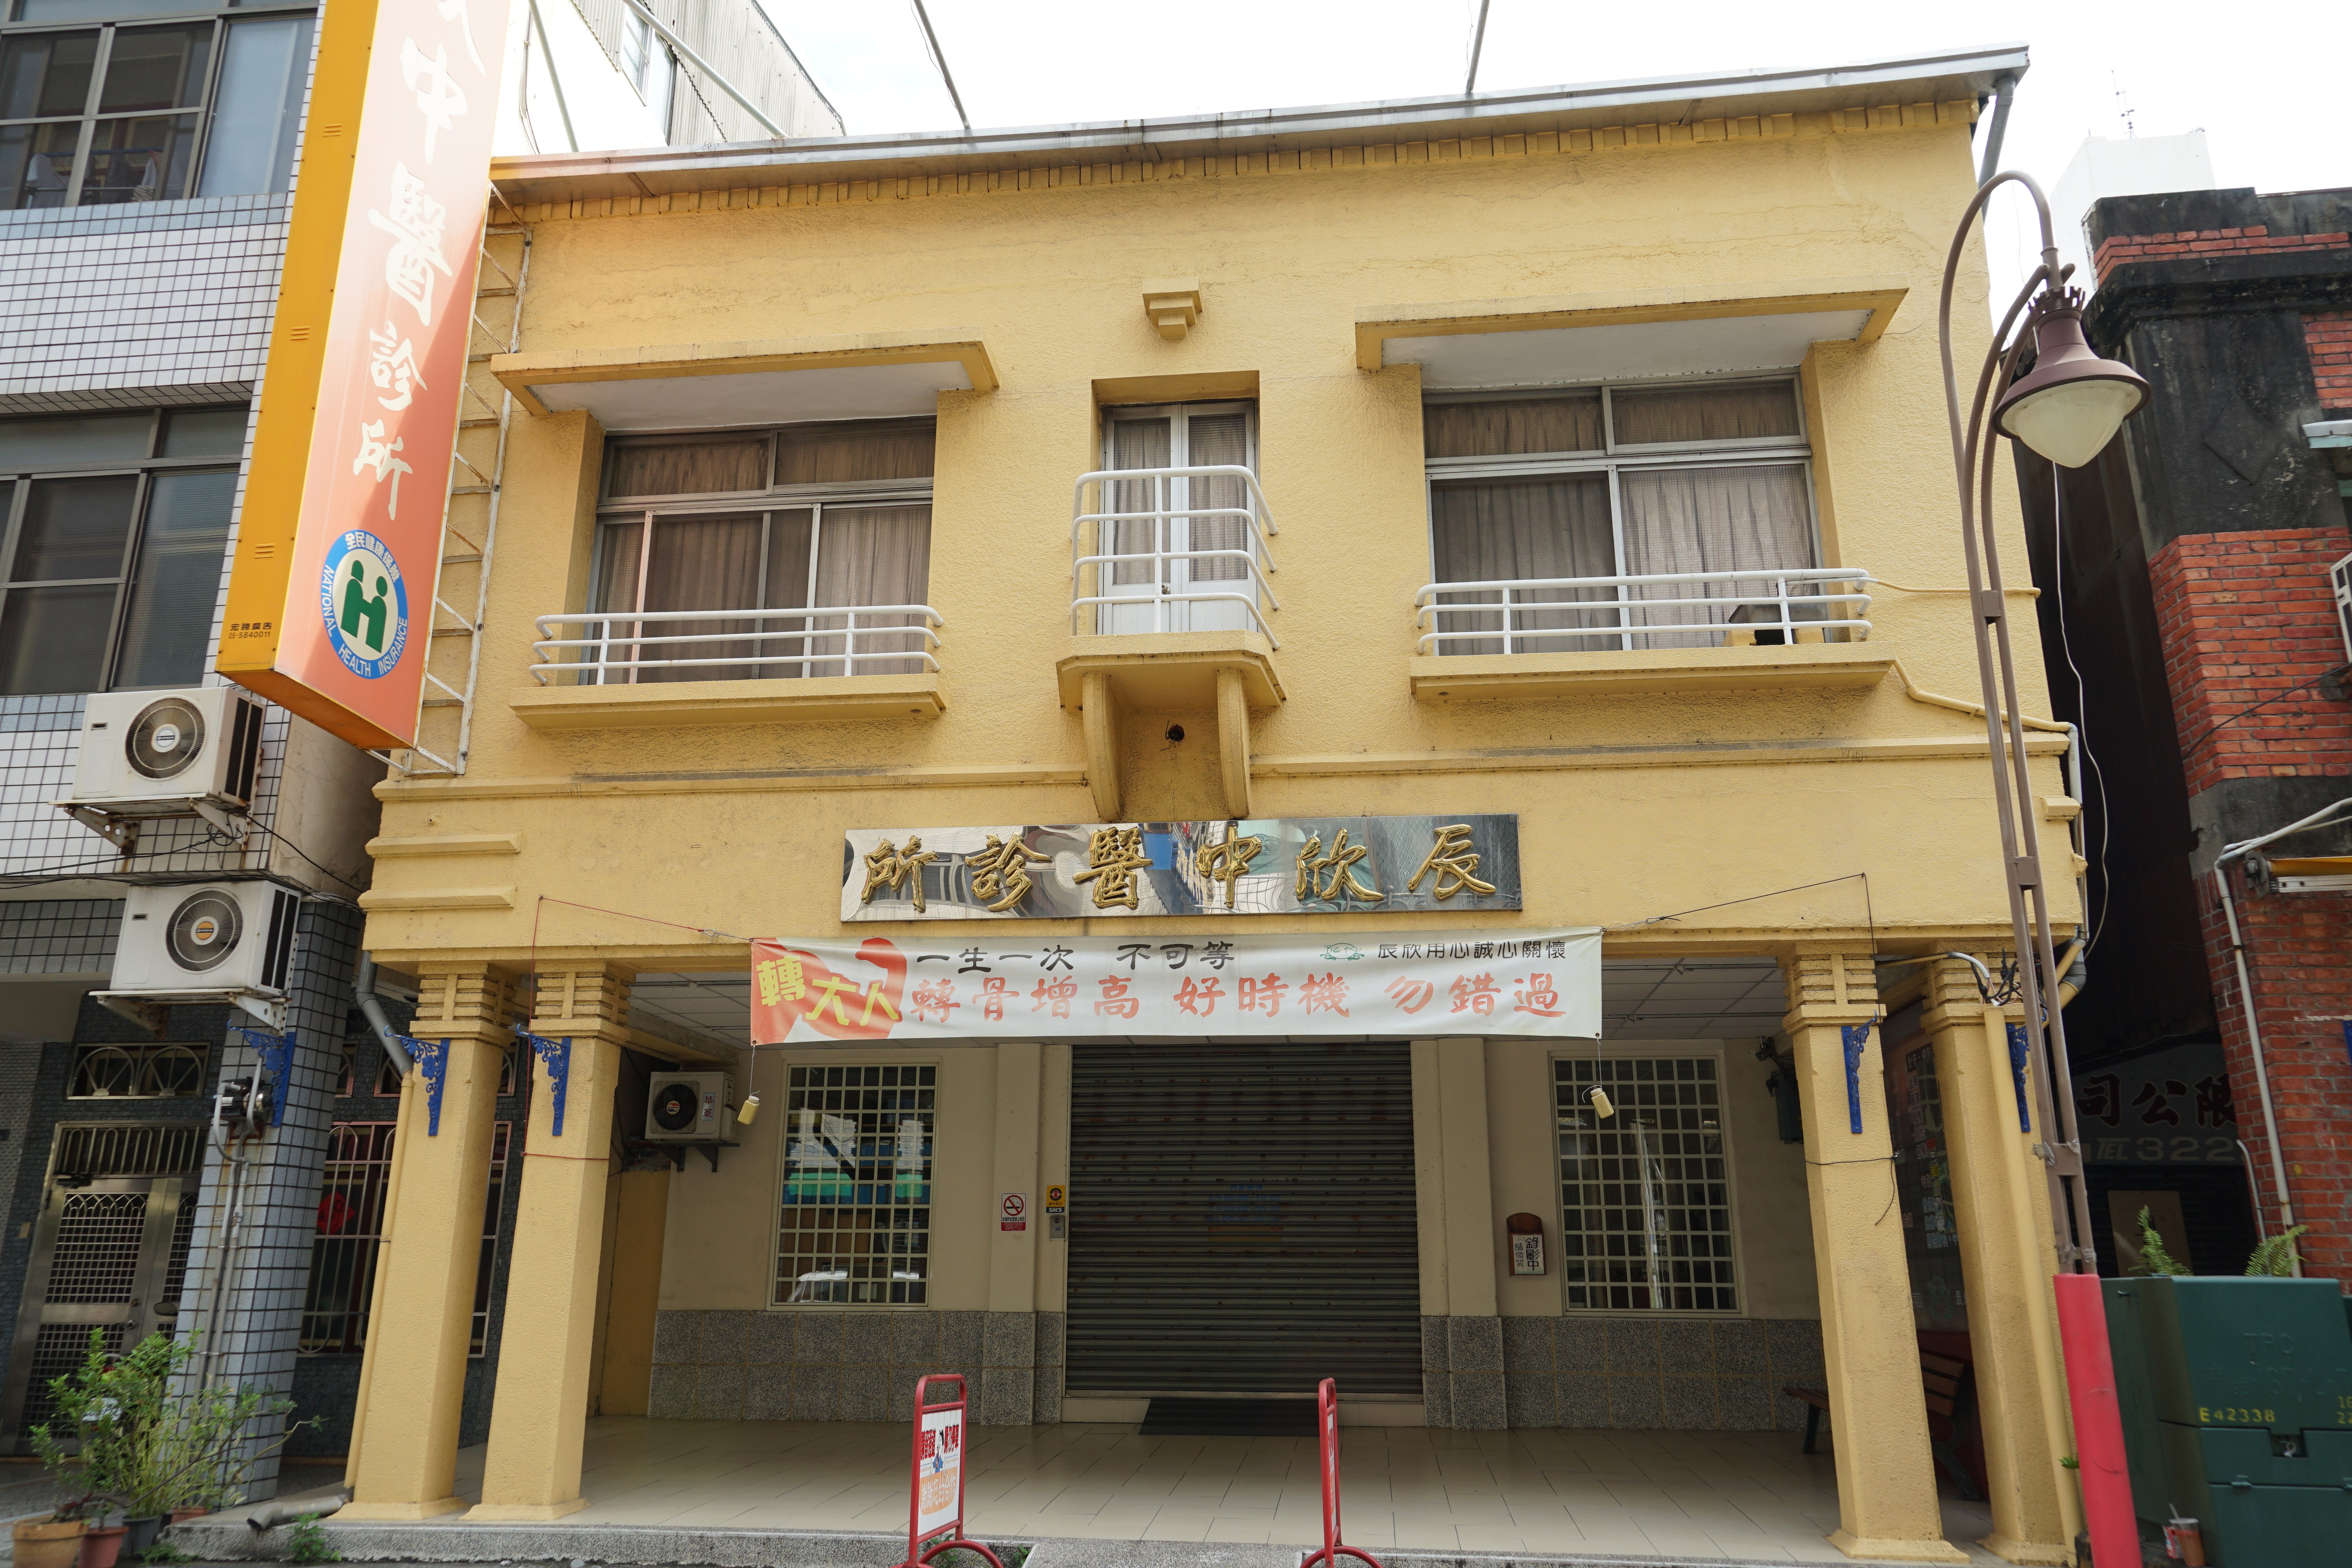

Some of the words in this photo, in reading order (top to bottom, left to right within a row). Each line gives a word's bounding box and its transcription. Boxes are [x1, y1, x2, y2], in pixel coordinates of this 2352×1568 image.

[352, 0, 488, 521] 中醫診所
[344, 532, 400, 583] 全民健康保險
[229, 631, 270, 639] 05-5840011
[321, 564, 337, 637] NATIONAL
[338, 643, 371, 677] HEALTH
[377, 616, 408, 676] INSURANCE
[861, 824, 1496, 913] 辰欣中醫診所
[916, 945, 1074, 974] 一生一次
[1115, 941, 1234, 970] 不可等
[1377, 940, 1567, 960] 辰欣用心誠心關懷
[756, 955, 900, 1027] 轉大人
[910, 975, 1140, 1023] 轉骨增高
[1173, 972, 1350, 1018] 好時機
[1384, 972, 1567, 1018] 勿錯過
[703, 1096, 713, 1117] 華菱
[2097, 1137, 2130, 1160] TEL
[1524, 1236, 1541, 1271] 錄影中
[2199, 1407, 2276, 1423] E42338
[921, 1472, 956, 1511] 謝謝您的合作
